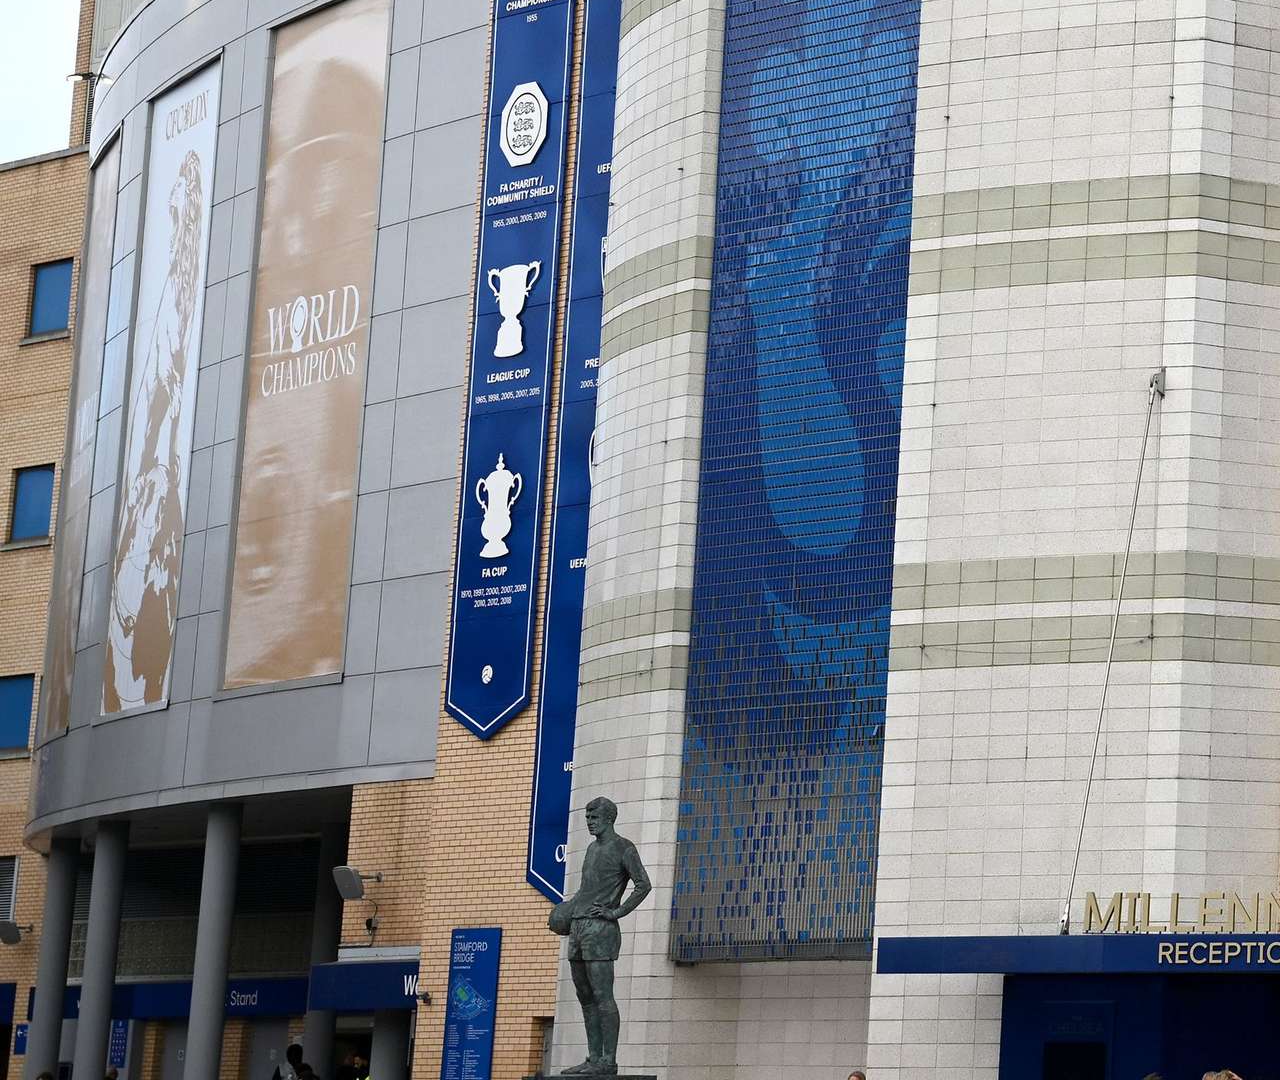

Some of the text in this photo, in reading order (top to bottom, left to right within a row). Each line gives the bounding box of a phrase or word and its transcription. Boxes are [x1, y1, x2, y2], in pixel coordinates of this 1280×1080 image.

[500, 183, 510, 192] FA
[510, 178, 538, 191] CHARITY
[487, 185, 554, 207] COMMUNITY SHIELD
[268, 285, 359, 356] WORLD
[262, 342, 357, 397] CHAMPIONS
[487, 368, 530, 384] LEAGUE CUP
[482, 567, 508, 578] FA CUP
[454, 942, 487, 952] STAMFORD
[454, 953, 475, 962] BRIDGE
[230, 990, 257, 1006] Stand
